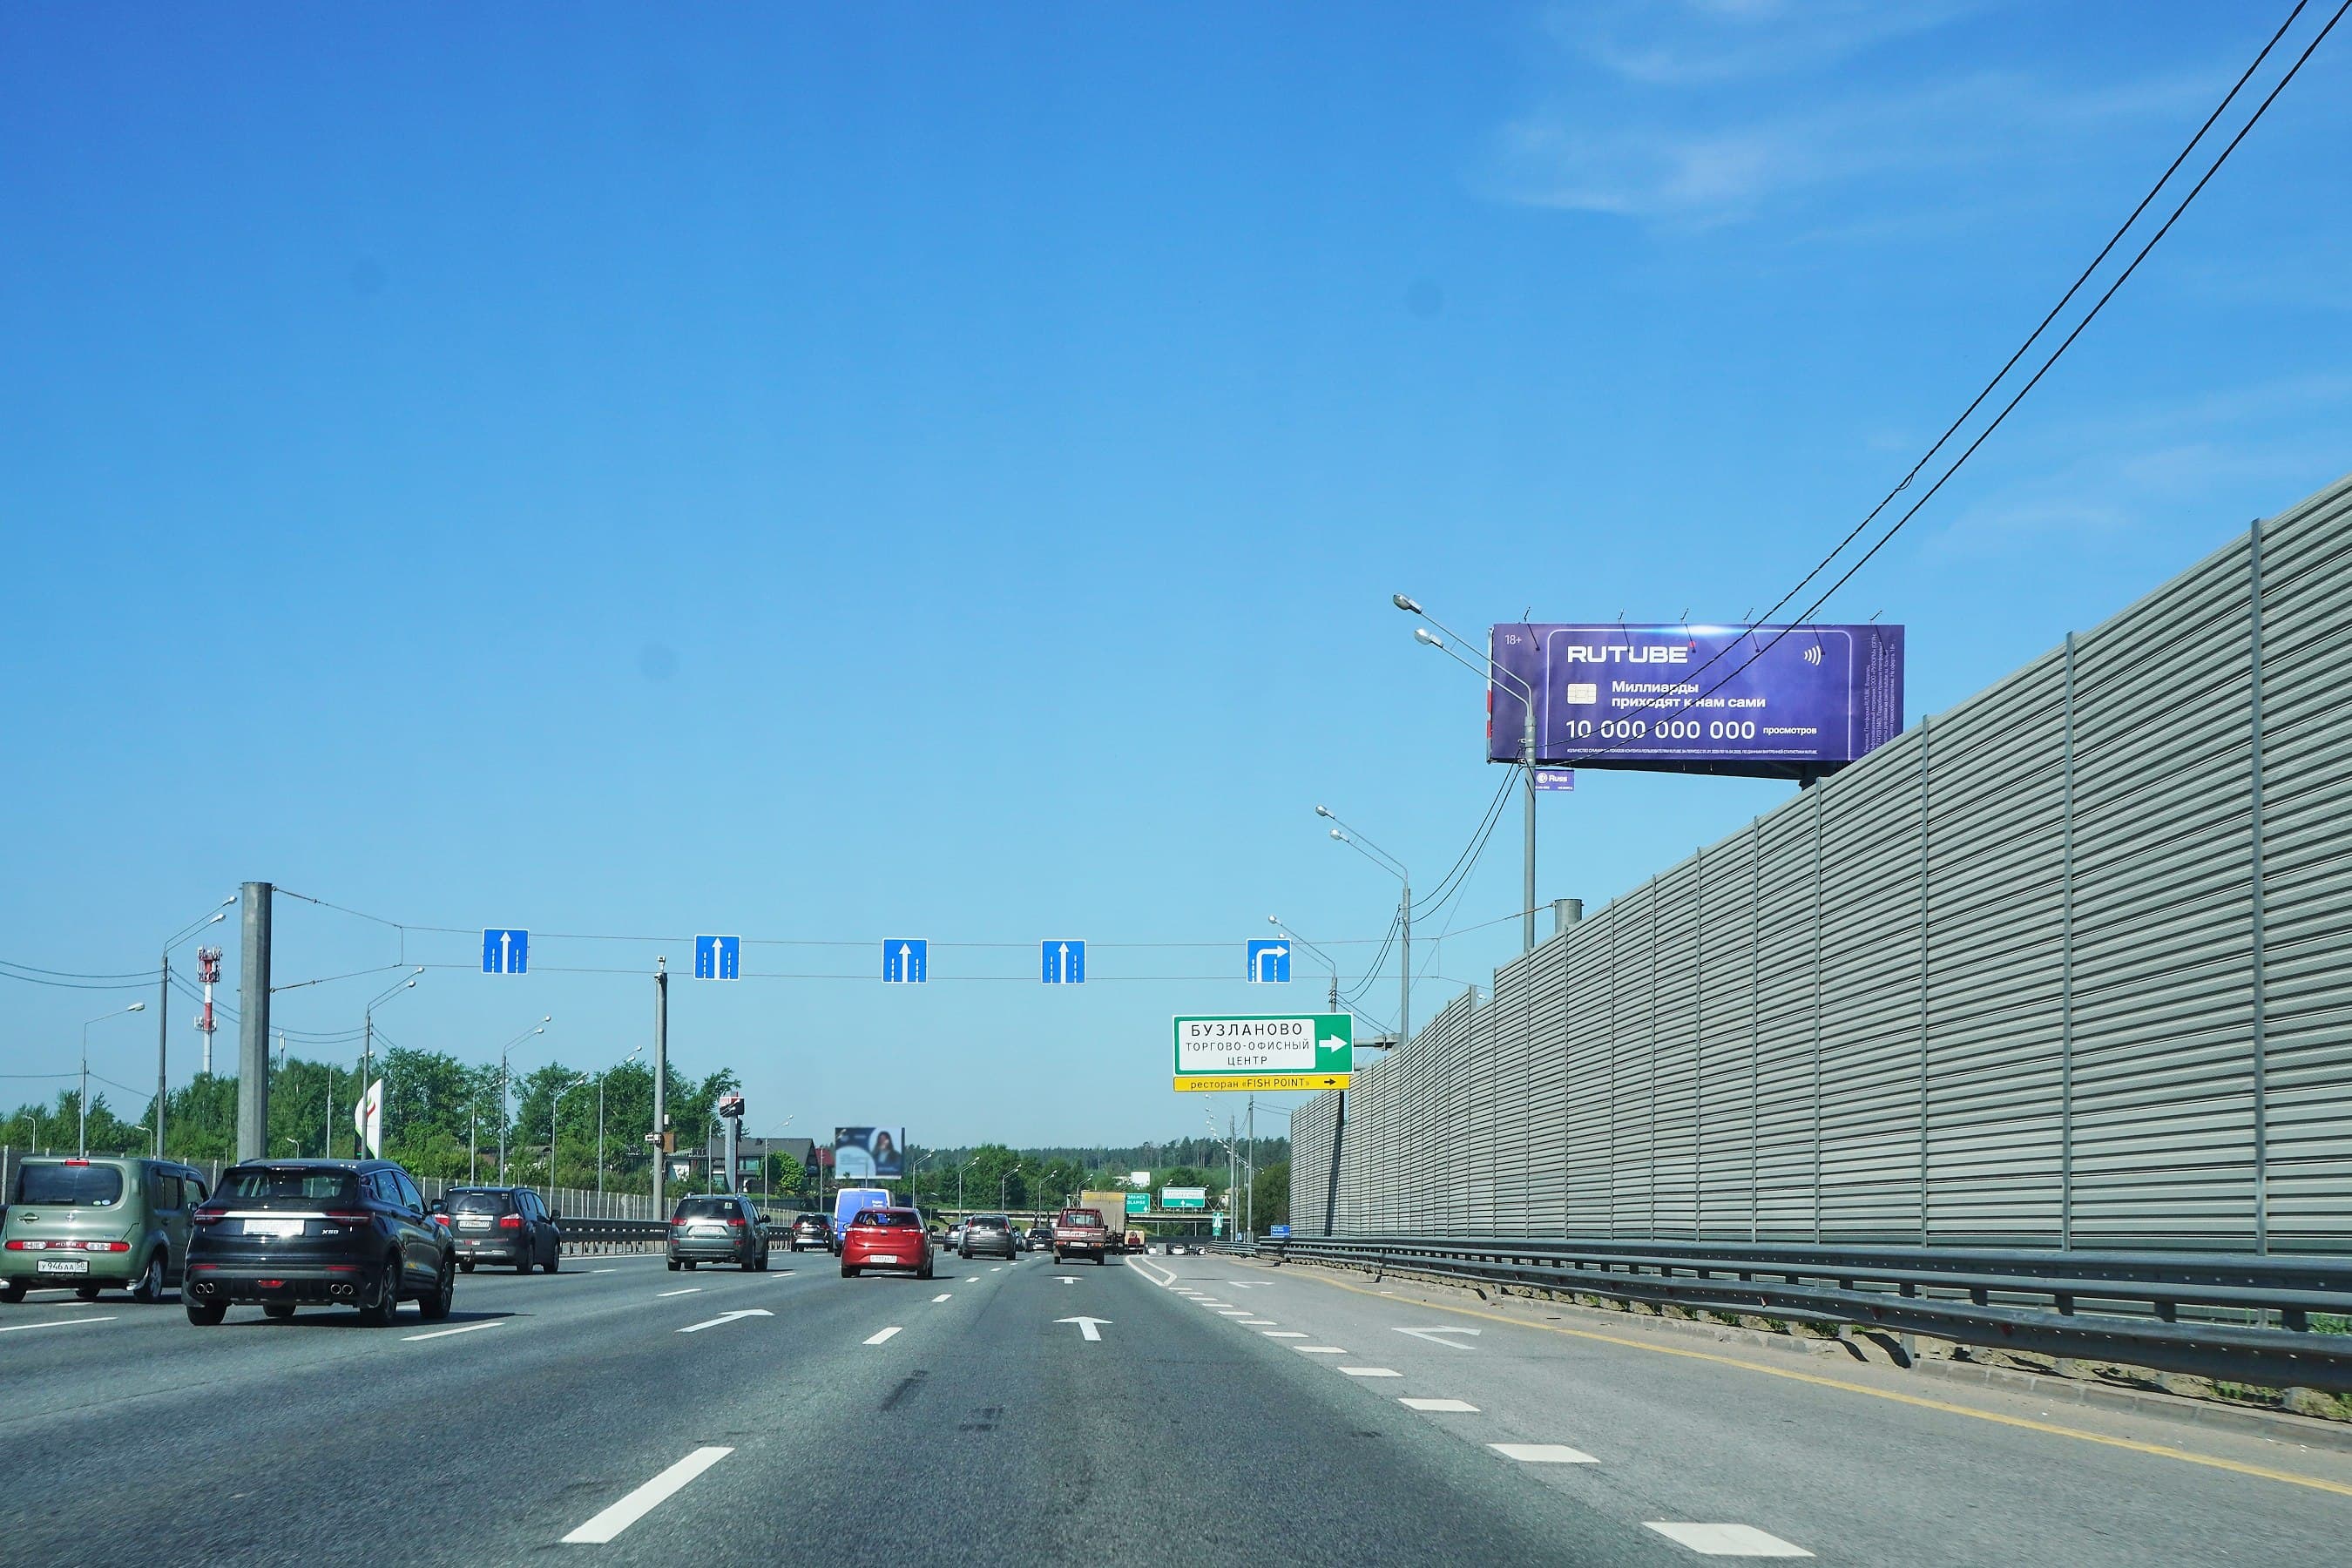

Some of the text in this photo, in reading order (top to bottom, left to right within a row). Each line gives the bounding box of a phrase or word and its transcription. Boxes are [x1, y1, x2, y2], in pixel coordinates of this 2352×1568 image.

[1504, 634, 1522, 645] 18+
[1567, 646, 1688, 663] RUTUBE
[1612, 680, 1699, 695] Миллиарды
[1612, 698, 1766, 709] приходят к нам сами
[1566, 720, 1817, 740] 10 000 000 000 просмотров
[1191, 1023, 1302, 1037] БУЗЛАНОВО
[1186, 1038, 1309, 1051] ТОРГОВО-ОФИСНЫЙ
[1227, 1056, 1267, 1066] ЦЕНТР
[1191, 1078, 1310, 1090] ресторан «FISH POINT»
